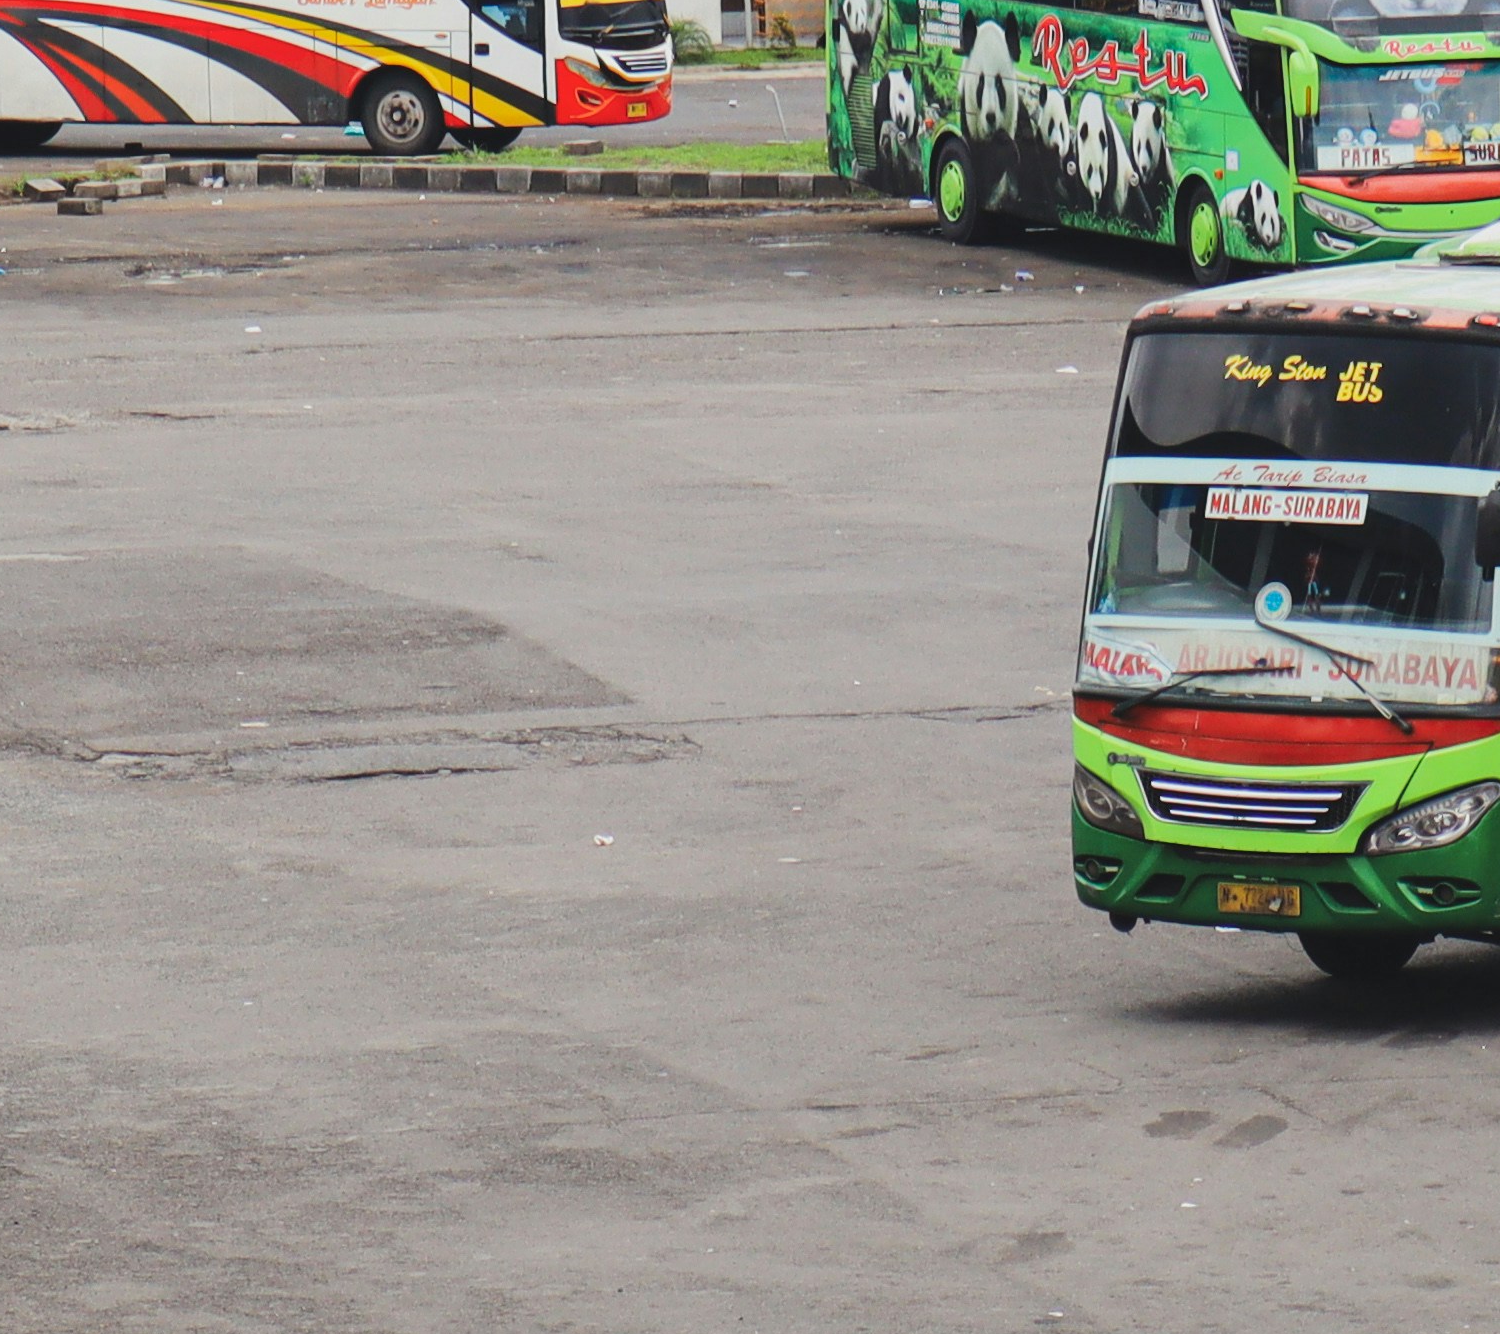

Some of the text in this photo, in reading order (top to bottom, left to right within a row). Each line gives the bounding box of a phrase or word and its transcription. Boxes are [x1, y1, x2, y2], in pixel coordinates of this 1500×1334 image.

[1032, 13, 1208, 100] Restu
[1383, 38, 1485, 59] Restu
[1378, 67, 1446, 82] JETBUS
[1341, 147, 1391, 167] PATAS
[1224, 354, 1384, 387] King Ston JET
[1336, 381, 1384, 403] BUS
[1213, 464, 1243, 482] Ac
[1313, 466, 1370, 485] Biasa
[1177, 643, 1479, 692] ARJOSARI SURABAYA
